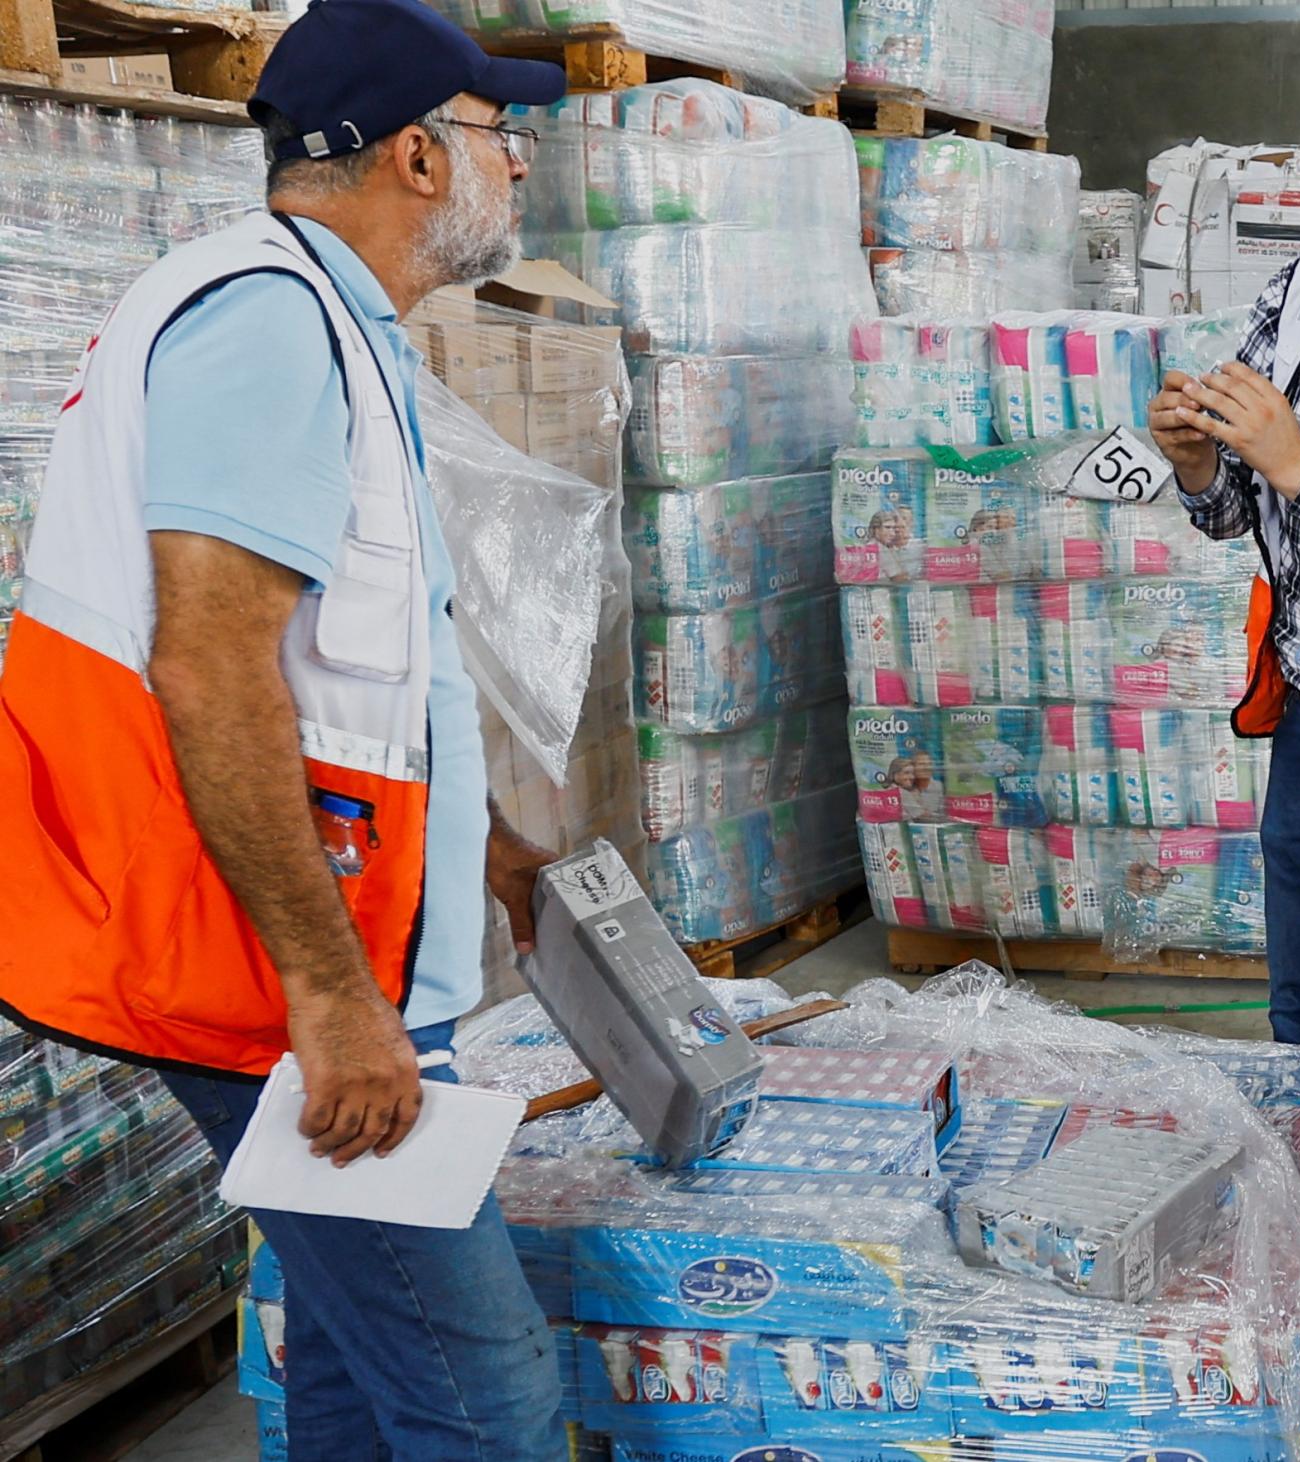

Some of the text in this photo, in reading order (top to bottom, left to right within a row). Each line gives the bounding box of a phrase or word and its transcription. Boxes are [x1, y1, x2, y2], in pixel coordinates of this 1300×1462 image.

[838, 464, 894, 486] predo
[1094, 445, 1152, 502] 56
[865, 551, 877, 563] 13
[935, 552, 978, 565] LARGE 13
[1124, 583, 1186, 605] predo
[950, 710, 991, 725] predo
[855, 714, 910, 737] predo
[887, 796, 899, 806] 13
[669, 1452, 725, 1462] Cheese
